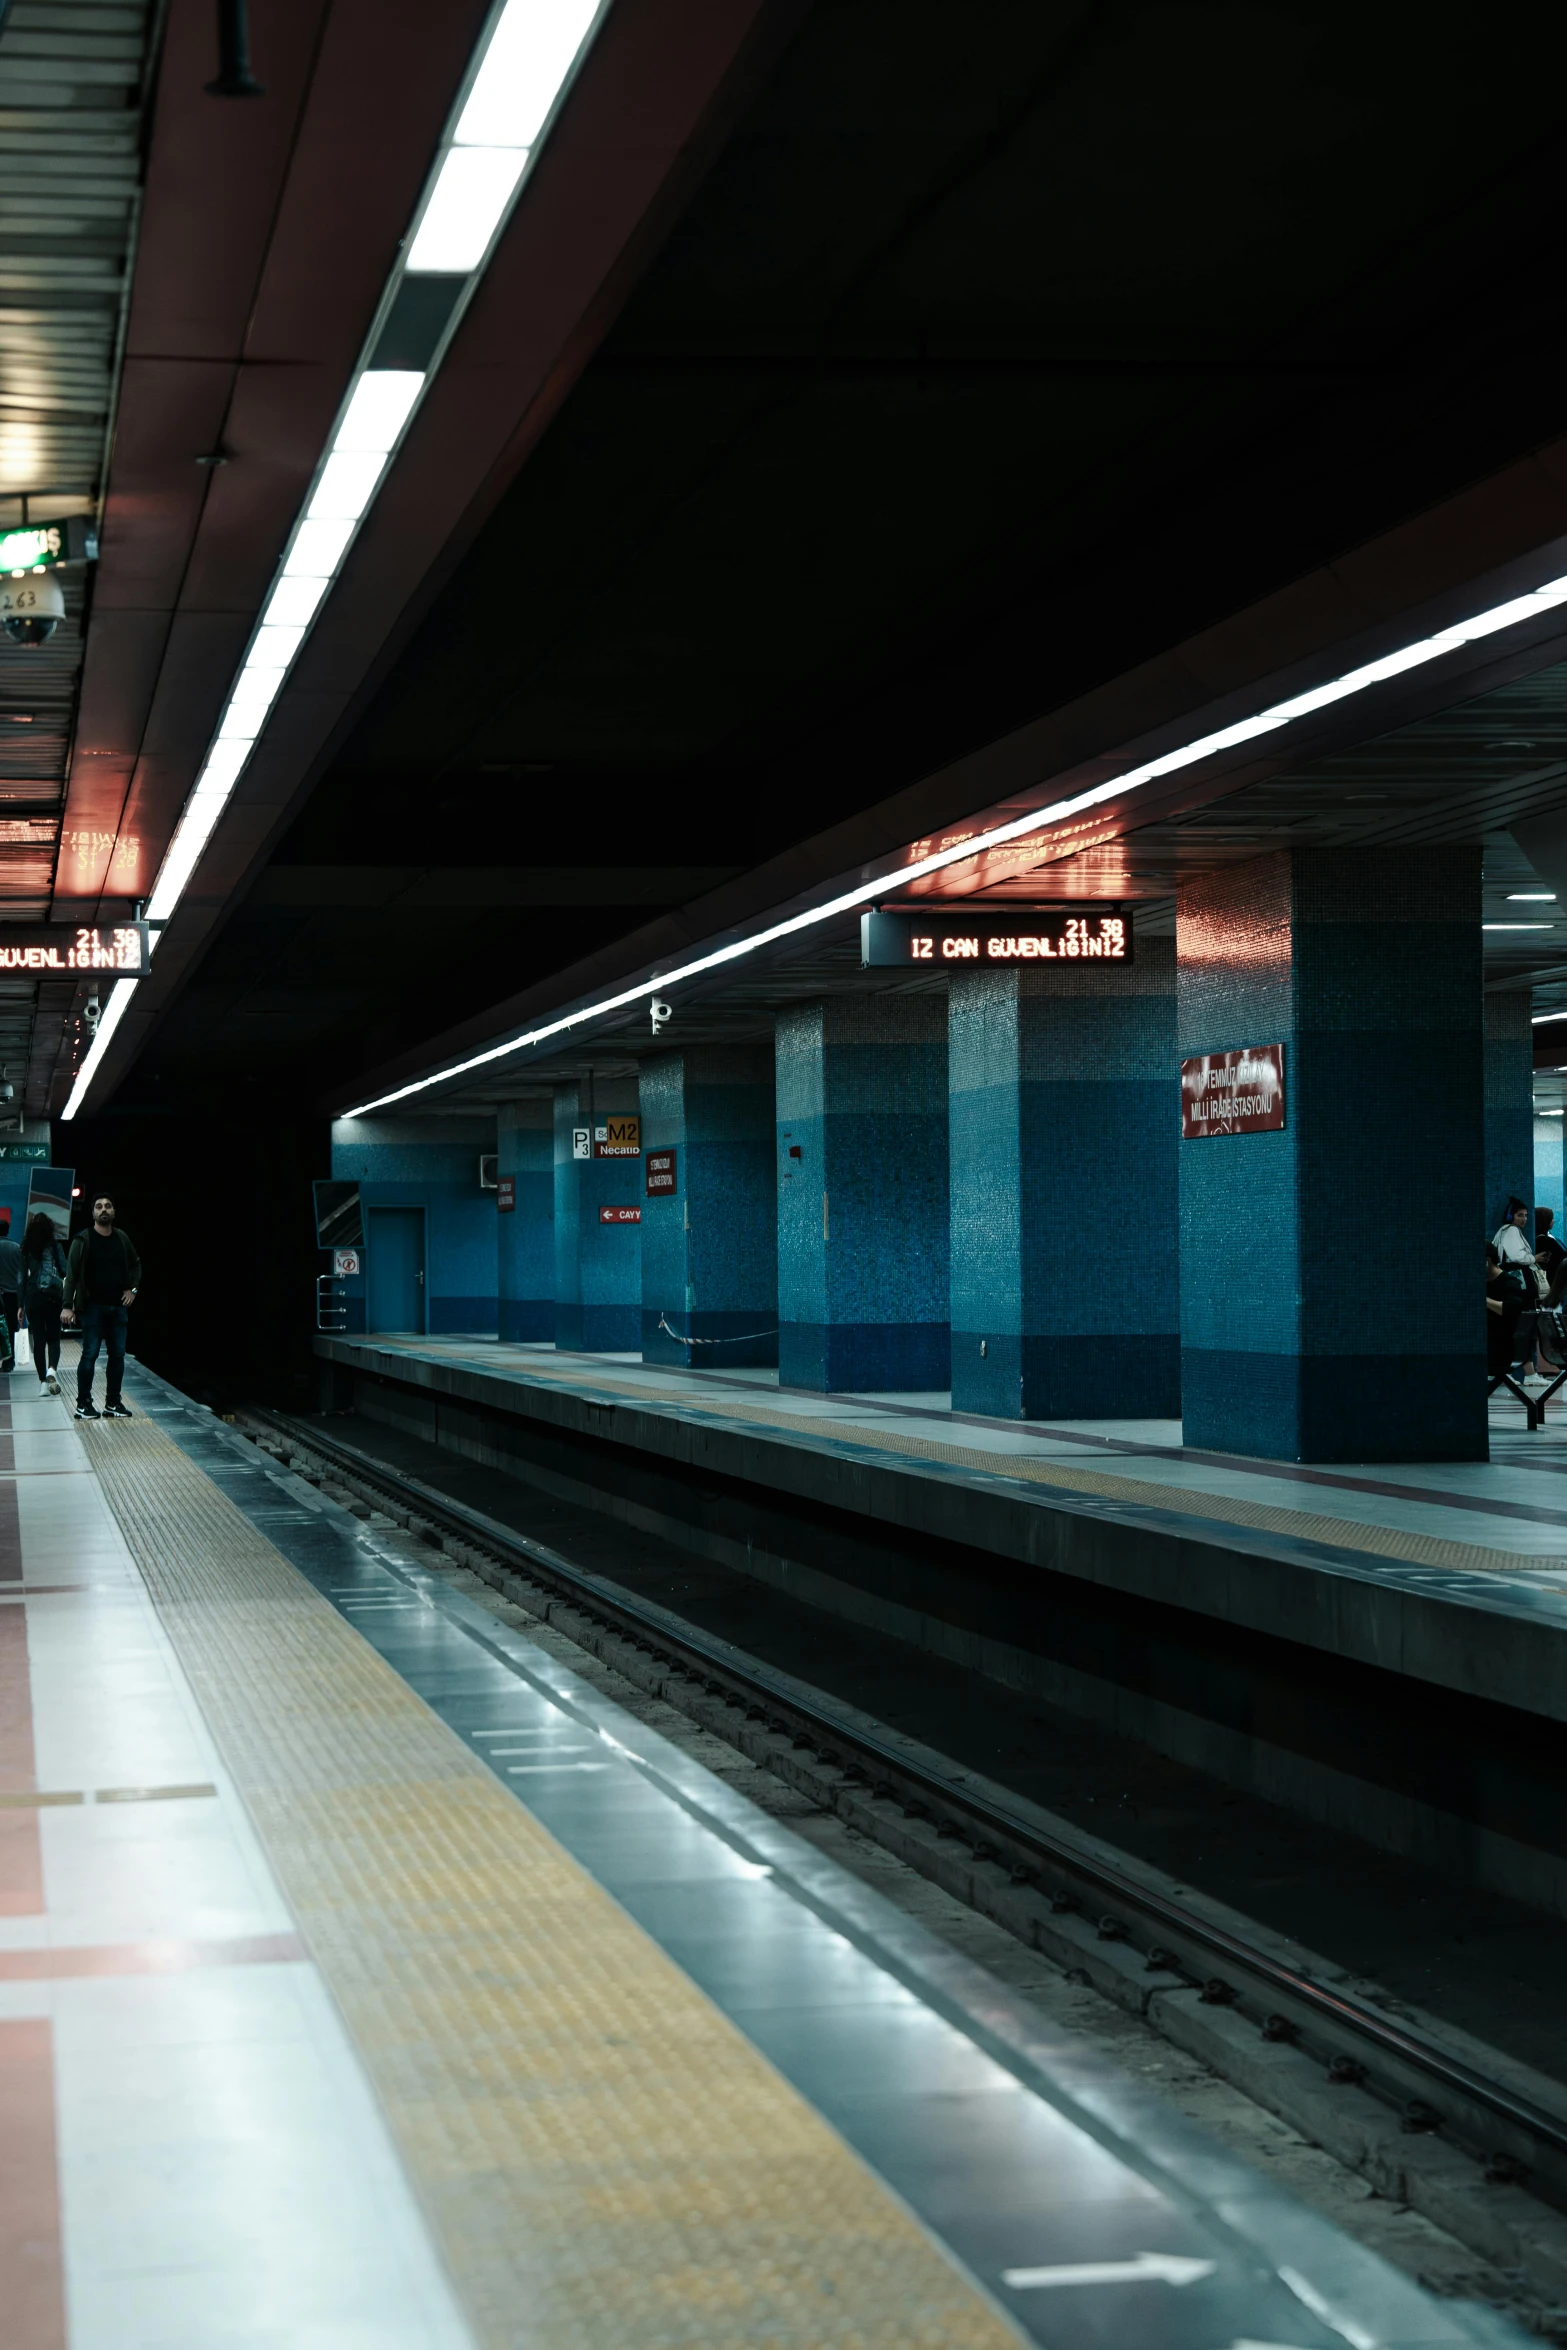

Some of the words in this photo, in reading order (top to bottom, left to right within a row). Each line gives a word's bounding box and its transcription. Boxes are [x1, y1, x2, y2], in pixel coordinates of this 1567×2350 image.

[3, 590, 36, 609] 263
[76, 928, 100, 948] 21
[113, 928, 138, 948] 38
[1066, 919, 1088, 938] 21
[1100, 919, 1123, 938] 38
[942, 938, 978, 957] CAN
[1207, 1066, 1236, 1089] TEMMUZ
[575, 1131, 588, 1149] P
[609, 1123, 637, 1141] M2
[582, 1143, 589, 1156] 3
